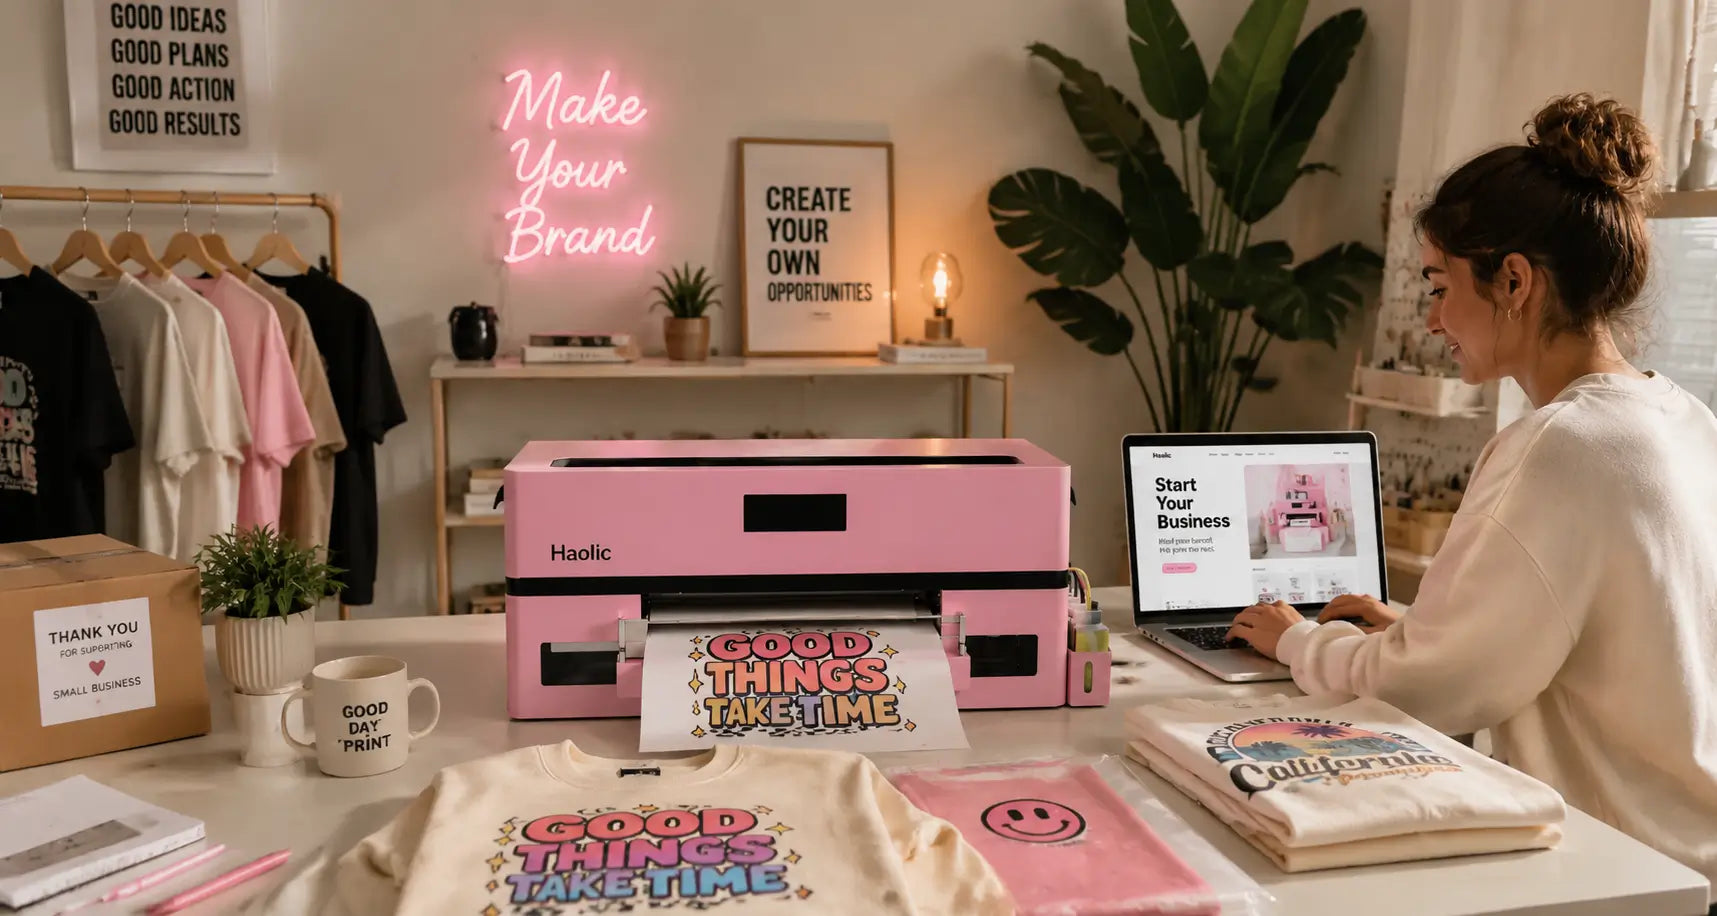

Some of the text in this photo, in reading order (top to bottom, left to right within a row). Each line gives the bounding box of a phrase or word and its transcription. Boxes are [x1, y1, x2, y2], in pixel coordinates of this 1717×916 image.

[111, 3, 227, 34] GOOD IDEAS
[111, 38, 229, 68] GOOD PLANS
[112, 73, 235, 102] GOOD ACTION
[502, 69, 648, 131] Make
[109, 109, 241, 136] GOOD RESULTS
[510, 138, 628, 207] Your
[766, 186, 852, 212] CREATE
[503, 204, 656, 263] Brand
[767, 218, 828, 243] YOUR
[767, 249, 820, 275] OWN
[767, 282, 873, 302] OPPORTUNITIES
[1155, 477, 1198, 492] Start
[1156, 495, 1194, 511] Your
[1157, 513, 1231, 529] Business
[551, 544, 612, 561] Haolic
[48, 621, 138, 645] THANK YOU
[707, 632, 873, 661] GOOD
[60, 648, 78, 659] FOR
[53, 676, 142, 700] SMALL BUSINESS
[704, 657, 890, 697] THINGS
[342, 701, 388, 718] GOOD
[704, 694, 901, 729] TAKE TIME
[521, 807, 758, 843] GOOD
[512, 834, 778, 874] THINGS
[505, 864, 791, 903] TAKE TIME
